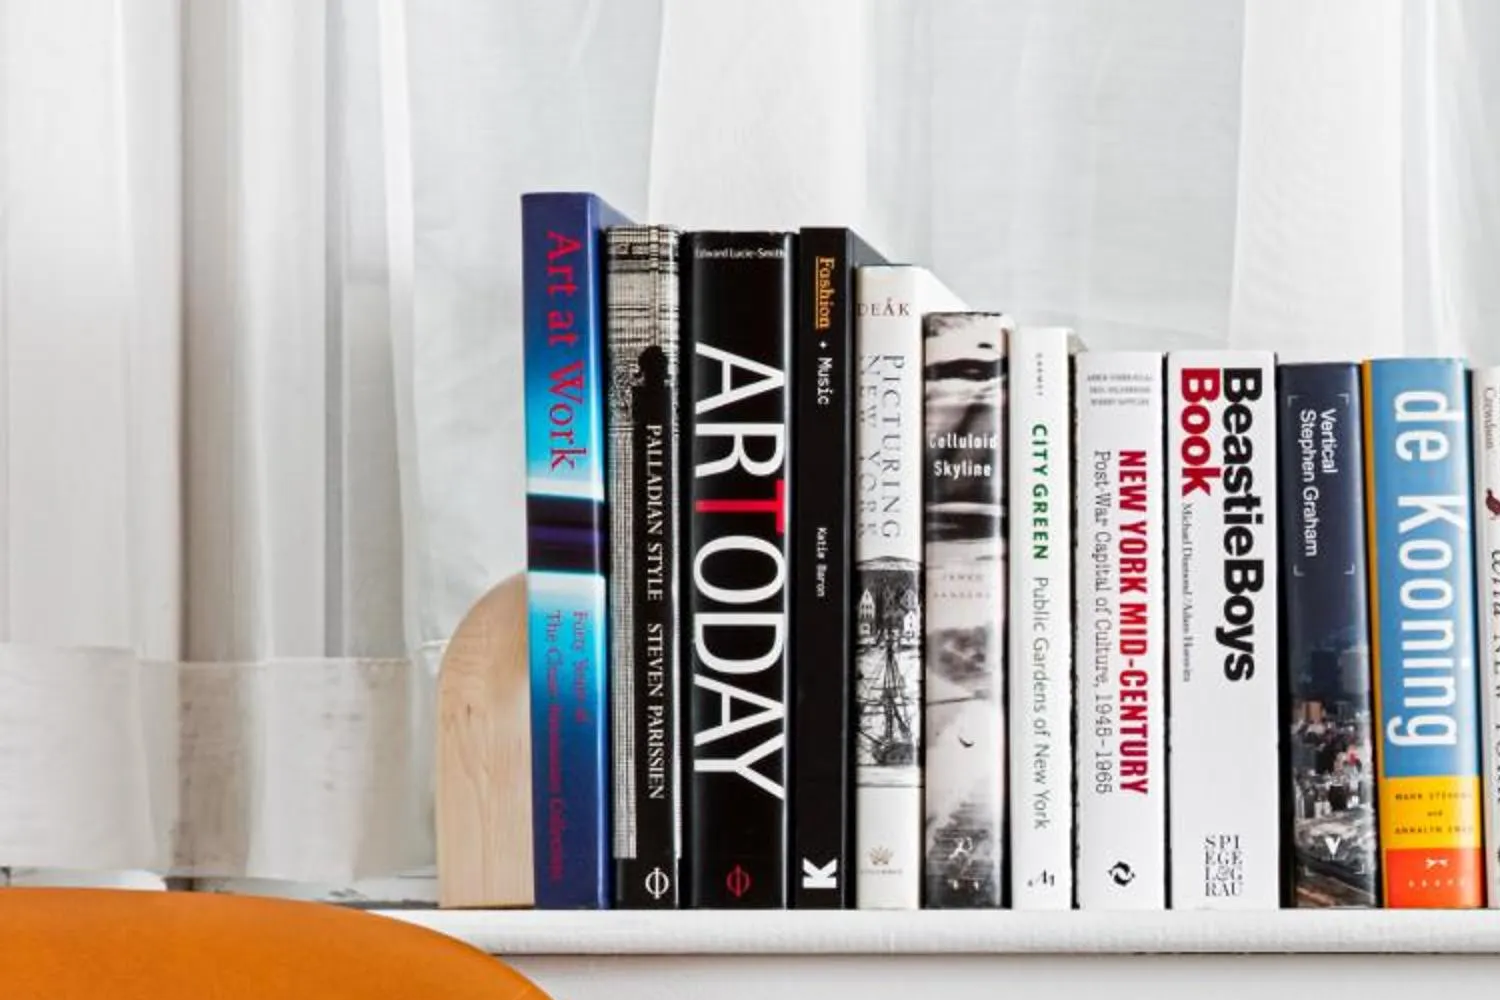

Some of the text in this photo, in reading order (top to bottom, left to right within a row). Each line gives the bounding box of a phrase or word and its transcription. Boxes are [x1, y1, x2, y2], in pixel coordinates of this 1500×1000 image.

[817, 256, 836, 329] Fashion
[546, 229, 587, 473] Art at Work
[817, 356, 834, 406] Music
[880, 354, 905, 539] PICTURING
[929, 432, 998, 449] Celluloid
[1180, 367, 1221, 498] Book
[1319, 407, 1339, 474] Vertical
[1393, 390, 1466, 462] de
[933, 459, 993, 481] Skyline
[1031, 423, 1050, 560] CITY GREEN
[1093, 450, 1112, 527] Post-War
[1298, 409, 1320, 557] Stephen Graham
[645, 424, 665, 601] PALLADIAN STYLE
[816, 526, 829, 562] Katie
[1181, 501, 1194, 546] Michael
[1092, 530, 1112, 593] Capital
[1094, 595, 1112, 614] of
[1118, 450, 1149, 796] NEW YORK MID-CENTURY
[647, 623, 666, 800] STEVEN PARISSIEN
[1033, 576, 1051, 831] Public Gardens of New York
[803, 857, 839, 889] K
